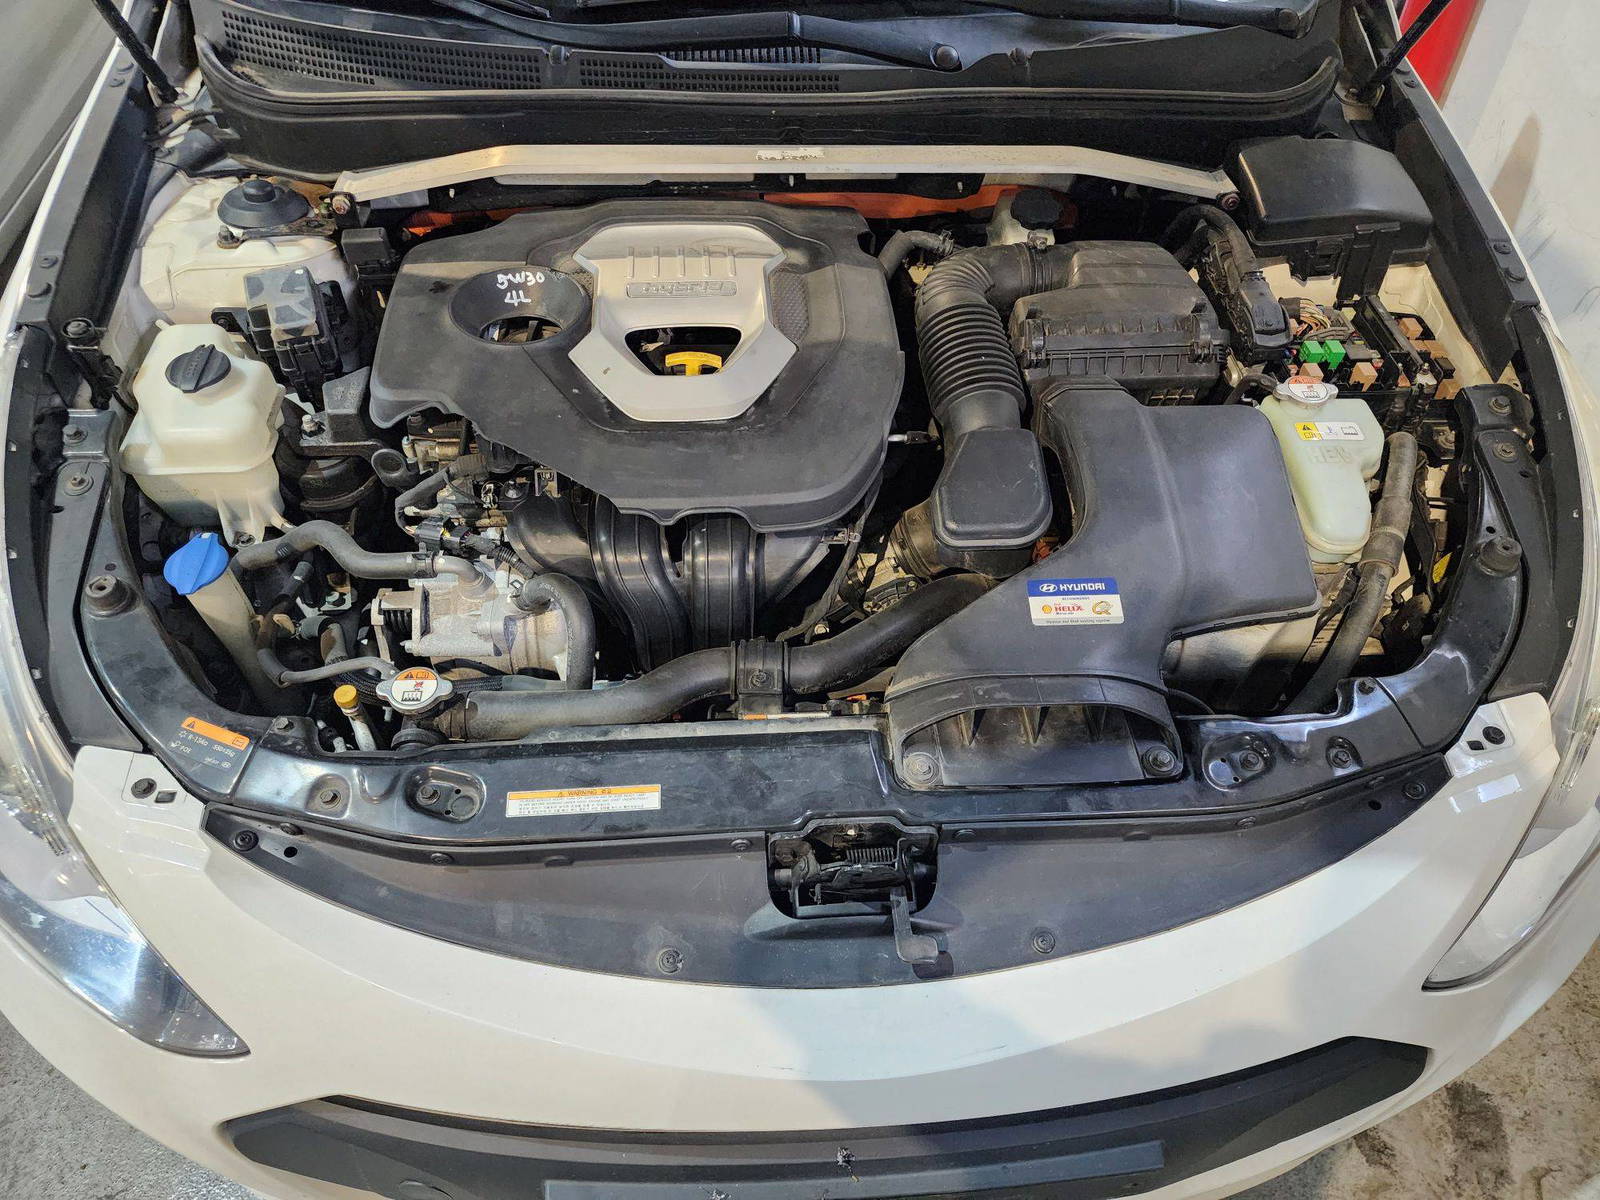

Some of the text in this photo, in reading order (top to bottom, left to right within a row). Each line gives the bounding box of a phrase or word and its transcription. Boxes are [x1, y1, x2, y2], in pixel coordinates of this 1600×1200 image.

[496, 271, 545, 289] 5W30
[504, 290, 532, 306] 4L
[1060, 583, 1106, 592] HYUNDAI
